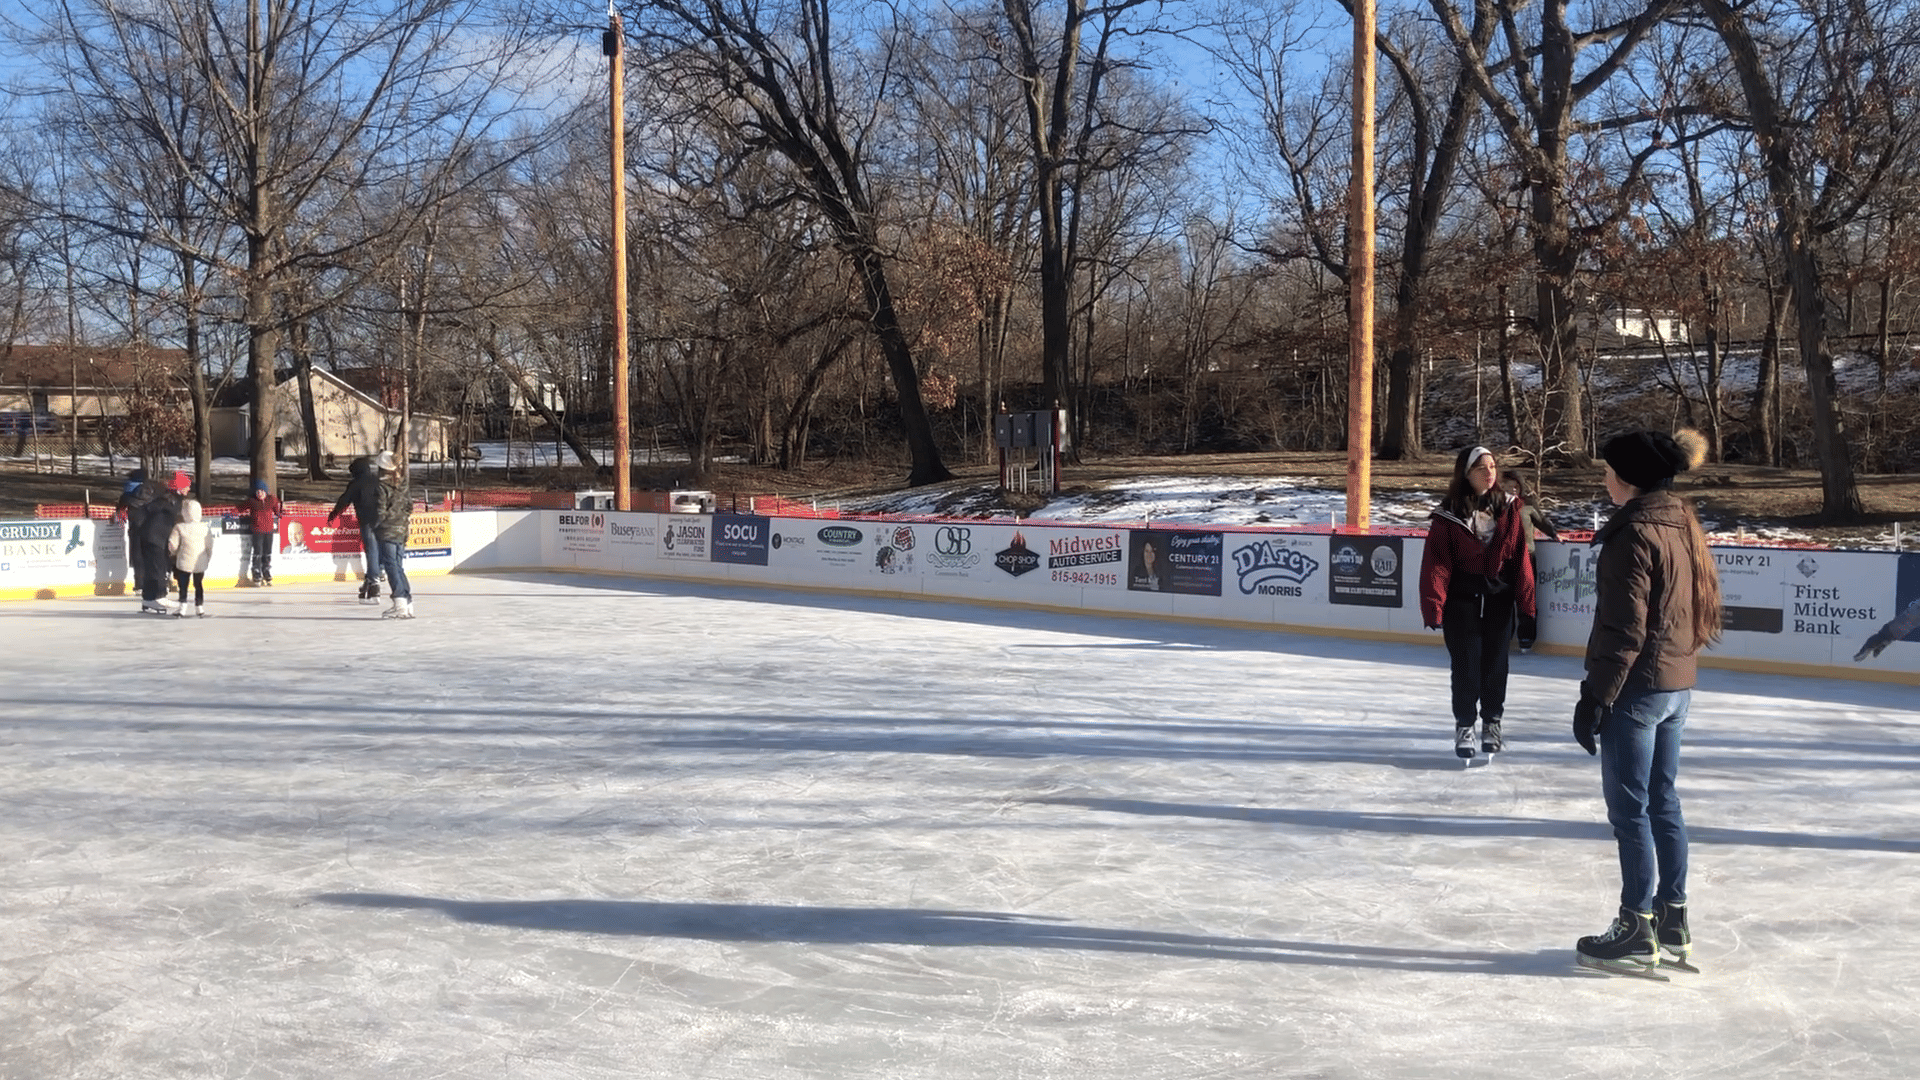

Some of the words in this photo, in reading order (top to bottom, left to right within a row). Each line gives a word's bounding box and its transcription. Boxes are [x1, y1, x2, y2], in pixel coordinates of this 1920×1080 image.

[559, 515, 590, 525] BELFOR
[0, 525, 60, 540] GRUNDY
[676, 525, 705, 539] JASON
[724, 524, 757, 540] SOCU
[823, 528, 858, 540] COUNTRY
[414, 537, 442, 545] CLUB
[1049, 533, 1121, 556] Midwest
[3, 543, 57, 556] BANK
[999, 555, 1018, 566] CHOP
[1018, 556, 1036, 565] SHOP
[1053, 555, 1077, 568] AUTO
[1078, 550, 1118, 565] SERVICE
[1168, 553, 1209, 564] CENTURY
[1211, 554, 1220, 565] 21
[1232, 540, 1319, 586] D'Arcy
[1712, 554, 1754, 567] TURY
[1758, 555, 1771, 568] 21
[1051, 569, 1117, 586] 815-942-1915
[1538, 565, 1568, 585] Baker
[1258, 585, 1303, 597] MORRIS
[1793, 584, 1840, 600] First
[1549, 601, 1596, 615] 815-941-
[1793, 602, 1877, 620] Midwest
[1793, 619, 1841, 635] Bank
